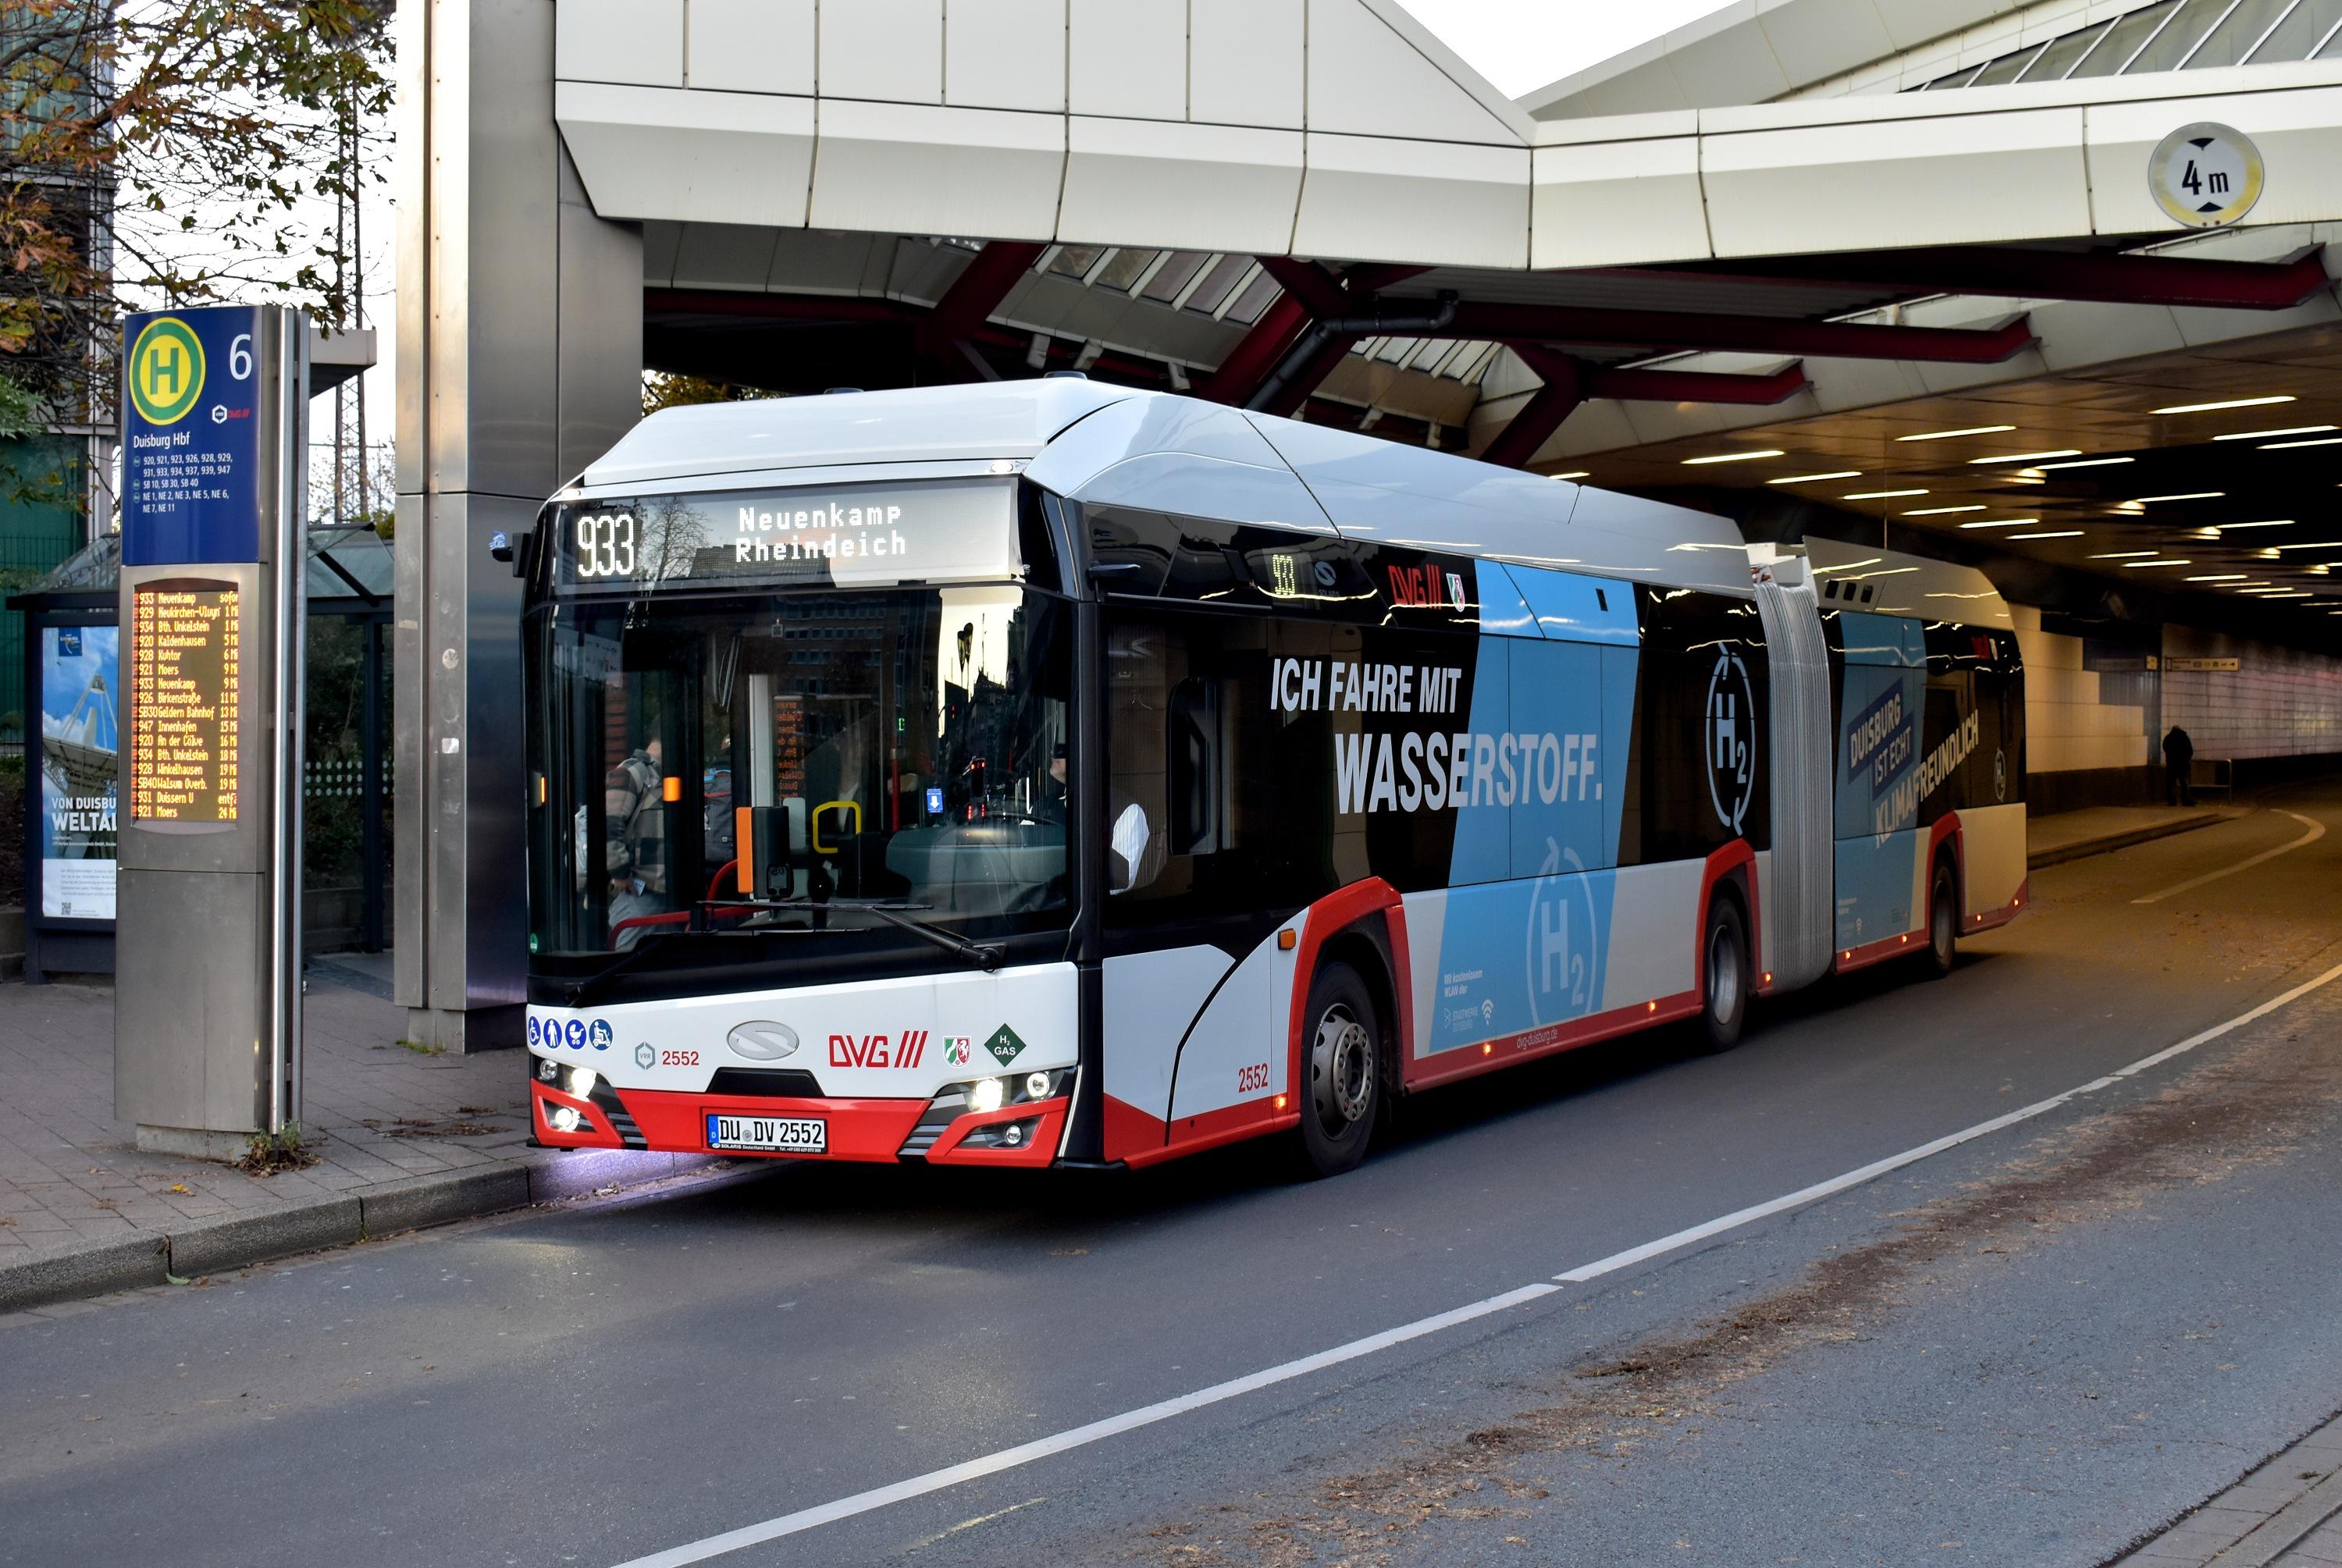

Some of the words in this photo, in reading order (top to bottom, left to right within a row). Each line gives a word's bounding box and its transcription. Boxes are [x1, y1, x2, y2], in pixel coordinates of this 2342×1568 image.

[2181, 159, 2201, 195] 4
[2209, 172, 2229, 194] m
[230, 334, 252, 380] 6
[150, 347, 179, 395] H
[133, 433, 170, 450] Duisburg
[173, 432, 190, 446] Hbf
[144, 456, 155, 465] 920,
[156, 455, 169, 464] 921,
[171, 454, 184, 464] 923,
[185, 453, 200, 464] 926,
[201, 453, 216, 463] 928,
[217, 453, 233, 462] 929,
[143, 468, 155, 478] 931,
[156, 468, 169, 477] 933,
[170, 467, 184, 476] 934,
[185, 466, 199, 476] 937,
[201, 465, 215, 475] 939,
[217, 464, 230, 475] 947
[143, 480, 150, 489] SB
[151, 480, 160, 489] 10,
[162, 479, 169, 489] SB
[169, 478, 180, 489] 30,
[180, 478, 189, 487] SB
[190, 478, 199, 487] 40
[152, 492, 157, 501] 1,
[158, 491, 166, 500] NE
[168, 491, 173, 500] 2,
[175, 490, 183, 500] NE
[185, 490, 191, 500] 3,
[193, 490, 201, 499] NE
[203, 489, 209, 500] 5,
[211, 489, 221, 499] NE
[222, 489, 230, 499] 6,
[143, 504, 150, 513] NE
[151, 504, 157, 514] 7,
[158, 503, 166, 512] NE
[169, 503, 175, 512] 11
[739, 503, 901, 532] Neuenkamp
[577, 514, 634, 576] 933
[735, 530, 906, 564] Rheindeich
[1272, 554, 1295, 595] 933
[139, 593, 154, 604] 933
[158, 592, 196, 606] Neuenkamp
[139, 607, 154, 618] 929
[225, 605, 230, 617] 1
[139, 620, 154, 632] 934
[158, 620, 172, 632] Bth.
[174, 620, 209, 632] Unkelstein
[225, 620, 230, 631] 1
[139, 635, 154, 646] 920
[158, 635, 206, 646] Kaldenhausen
[224, 635, 230, 645] 5
[139, 649, 154, 661] 928
[158, 649, 181, 661] Kuhtor
[223, 649, 229, 660] 6
[138, 663, 153, 675] 921
[158, 663, 180, 675] Moers
[224, 663, 229, 674] 9
[138, 677, 153, 689] 933
[158, 677, 195, 692] Neuenkamp
[224, 677, 229, 688] 9
[1270, 658, 1322, 712] ICH
[1329, 662, 1412, 713] FAHRE
[1418, 666, 1462, 713] MIT
[138, 692, 154, 703] 926
[158, 692, 201, 706] Birkenstraße
[220, 692, 229, 703] 11
[138, 706, 158, 718] SB30
[158, 706, 184, 718] Geldern
[187, 706, 215, 720] Bahnhof
[220, 706, 229, 718] 13
[138, 720, 153, 732] 947
[158, 720, 197, 734] Innenhafen
[220, 720, 229, 732] 15
[1851, 693, 1901, 769] DUISBURG
[138, 734, 153, 746] 920
[158, 734, 166, 746] An
[169, 734, 181, 746] der
[220, 735, 228, 746] 16
[1716, 693, 1746, 784] H2
[137, 748, 153, 760] 934
[157, 748, 172, 760] Bth.
[173, 749, 208, 760] Unkelstein
[219, 749, 228, 761] 18
[1875, 749, 1888, 786] IST
[1890, 725, 1911, 770] ECHT
[137, 763, 153, 774] 928
[157, 763, 203, 775] Winkelhausen
[219, 764, 228, 775] 19
[1335, 731, 1603, 814] WASSERSTOFF.
[137, 777, 157, 789] SB40
[157, 777, 183, 789] Walsum
[184, 778, 208, 790] Overb.
[219, 778, 228, 790] 19
[1876, 709, 1979, 848] KLIMAFREUNDLICH
[52, 797, 73, 809] VON
[76, 797, 116, 809] DUISBU
[137, 791, 152, 803] 931
[157, 791, 187, 803] Duissern
[188, 792, 194, 804] U
[137, 805, 151, 817] 921
[157, 805, 178, 818] Moers
[219, 807, 227, 819] 24
[1541, 898, 1584, 1006] H2
[1453, 969, 1482, 983] kostenlosem
[1444, 986, 1458, 998] WLAN
[1459, 984, 1468, 994] der
[1517, 1027, 1557, 1051] dvg-duisburg.de
[662, 1051, 699, 1065] 2552
[994, 1047, 1016, 1056] GAS
[1238, 1063, 1269, 1093] 2552
[720, 1119, 741, 1141] DU
[753, 1121, 774, 1142] DV
[780, 1122, 822, 1144] 2552
